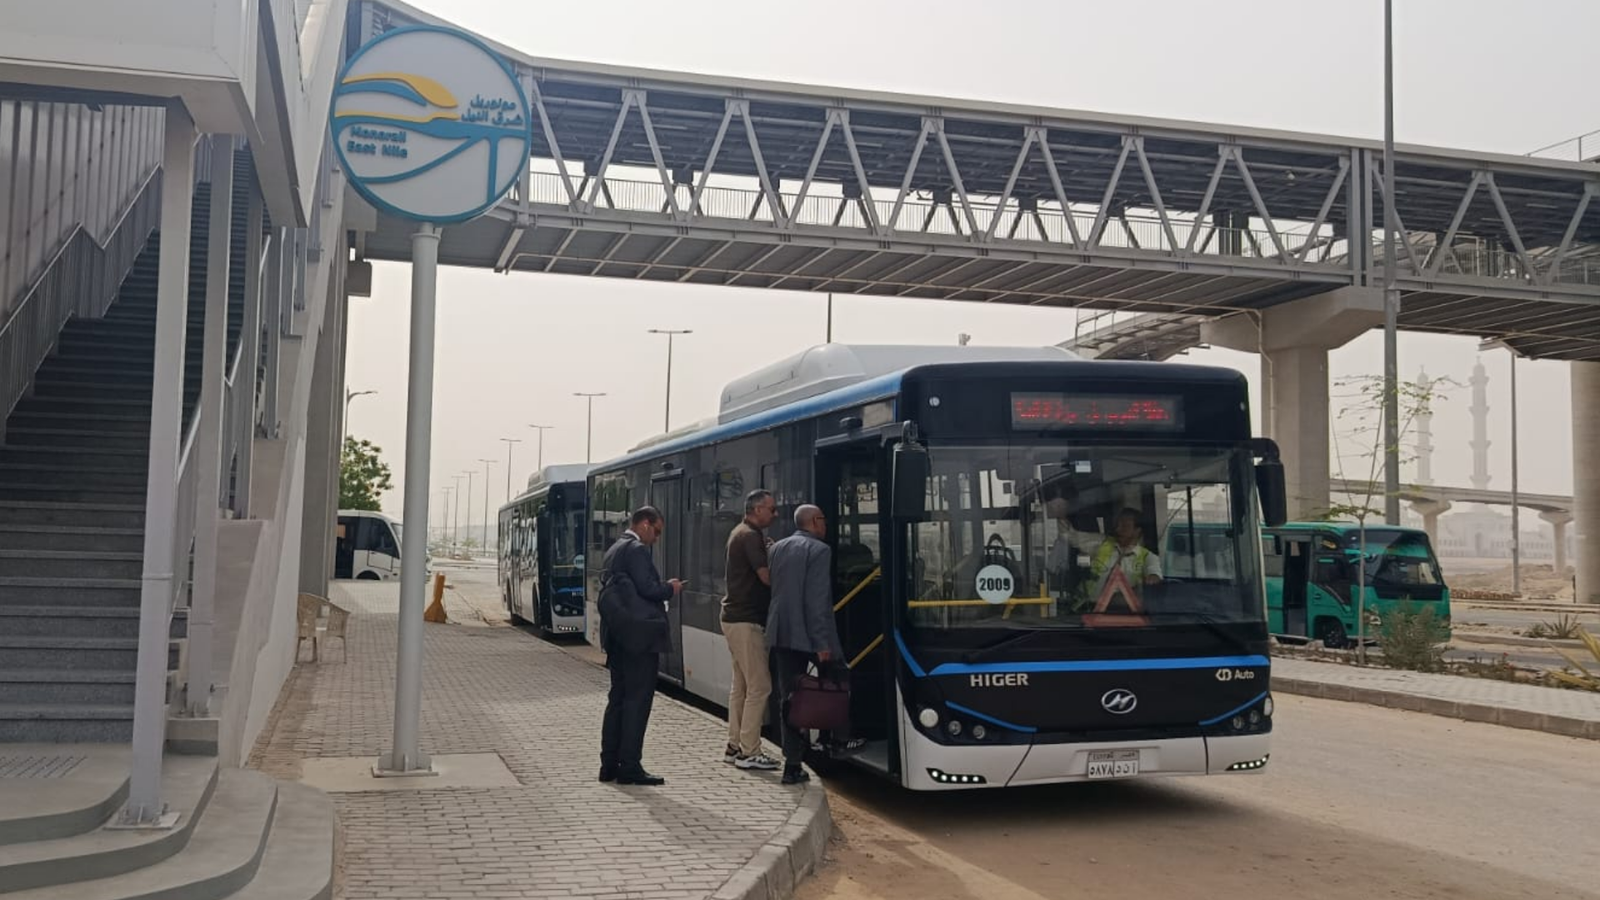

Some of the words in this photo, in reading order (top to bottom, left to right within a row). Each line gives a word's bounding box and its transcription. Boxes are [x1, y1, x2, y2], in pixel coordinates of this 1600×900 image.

[470, 94, 516, 111] مونوريل
[461, 108, 488, 122] النيل
[491, 111, 523, 126] شرق
[351, 126, 406, 143] Monorail
[347, 140, 376, 156] East
[382, 144, 408, 159] Nile
[979, 577, 1011, 591] 2009
[970, 673, 1029, 687] HIGER
[1234, 669, 1255, 680] Auto
